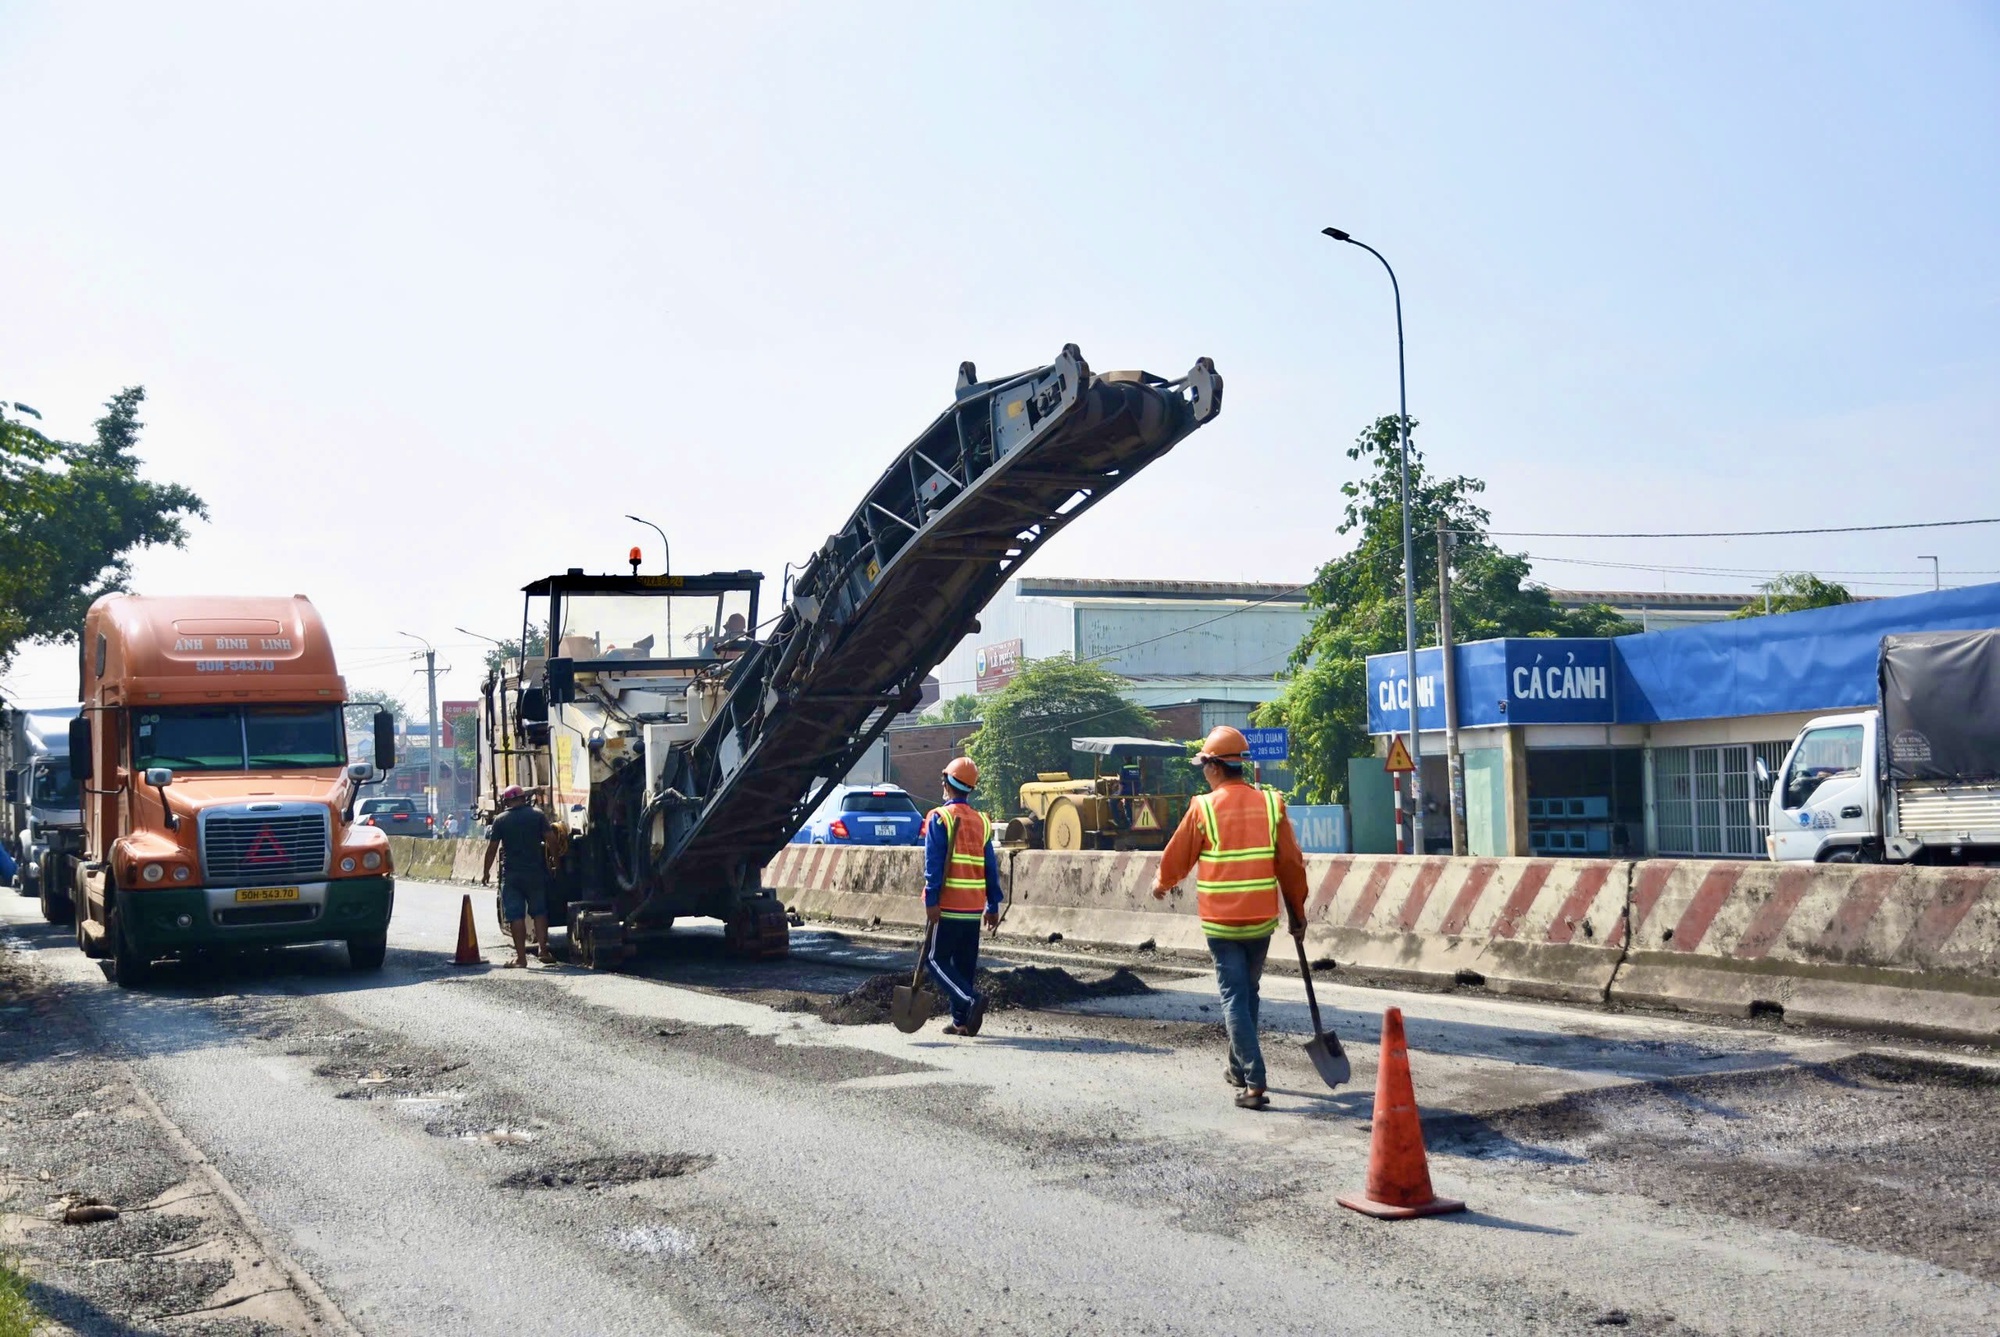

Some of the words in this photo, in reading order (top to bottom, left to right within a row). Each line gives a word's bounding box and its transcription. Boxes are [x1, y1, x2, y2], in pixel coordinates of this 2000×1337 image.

[261, 639, 292, 650] LINH
[1378, 668, 1397, 712] CÁ
[1397, 675, 1435, 710] CNH
[1513, 653, 1544, 699] CÁ
[1546, 651, 1606, 699] CẢNH
[1290, 806, 1341, 848] ẢNH
[241, 889, 294, 900] 50H-543.70
